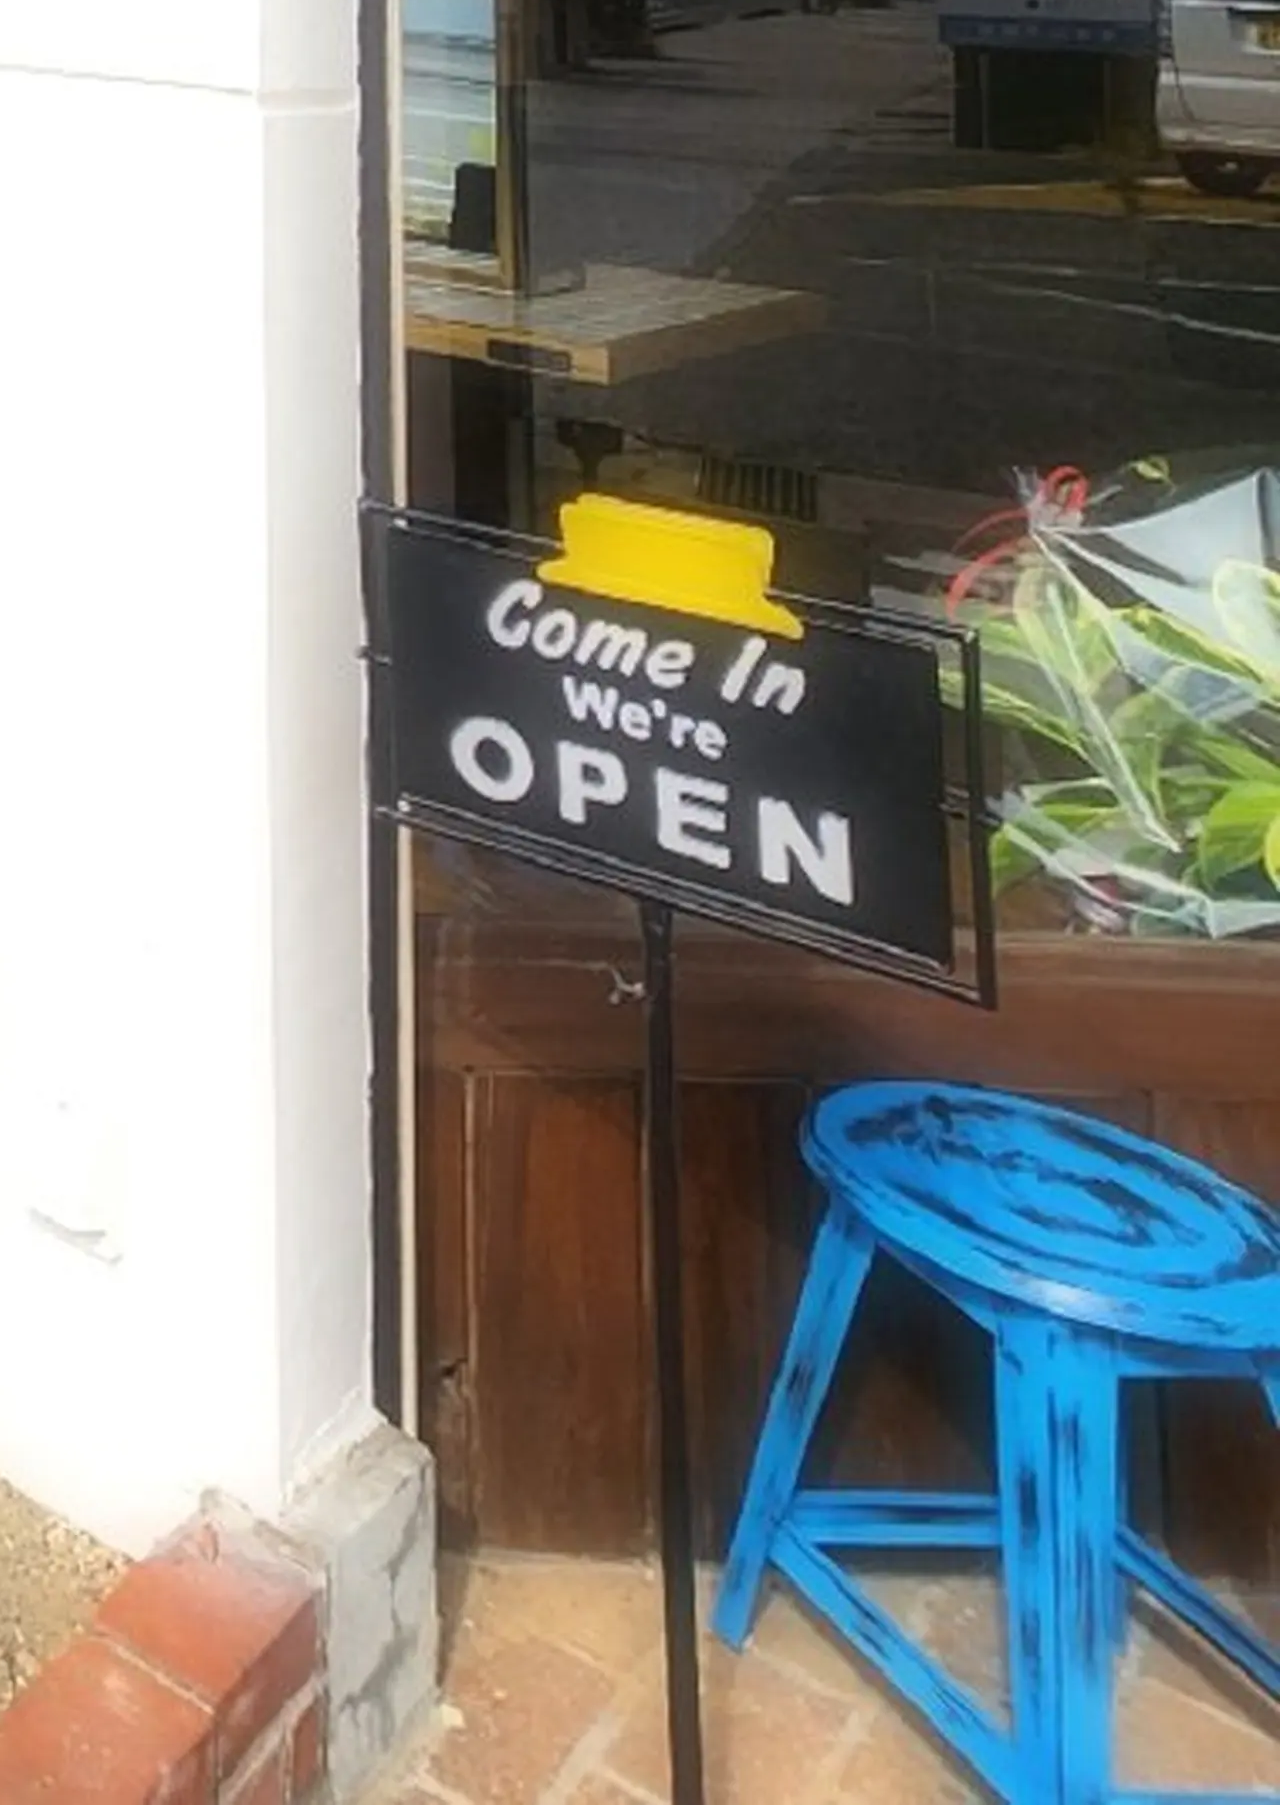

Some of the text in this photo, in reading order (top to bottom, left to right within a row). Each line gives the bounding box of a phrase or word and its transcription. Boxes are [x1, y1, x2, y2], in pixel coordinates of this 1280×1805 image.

[485, 579, 807, 715] Come In
[562, 674, 728, 760] We're
[449, 716, 854, 907] OPEN
